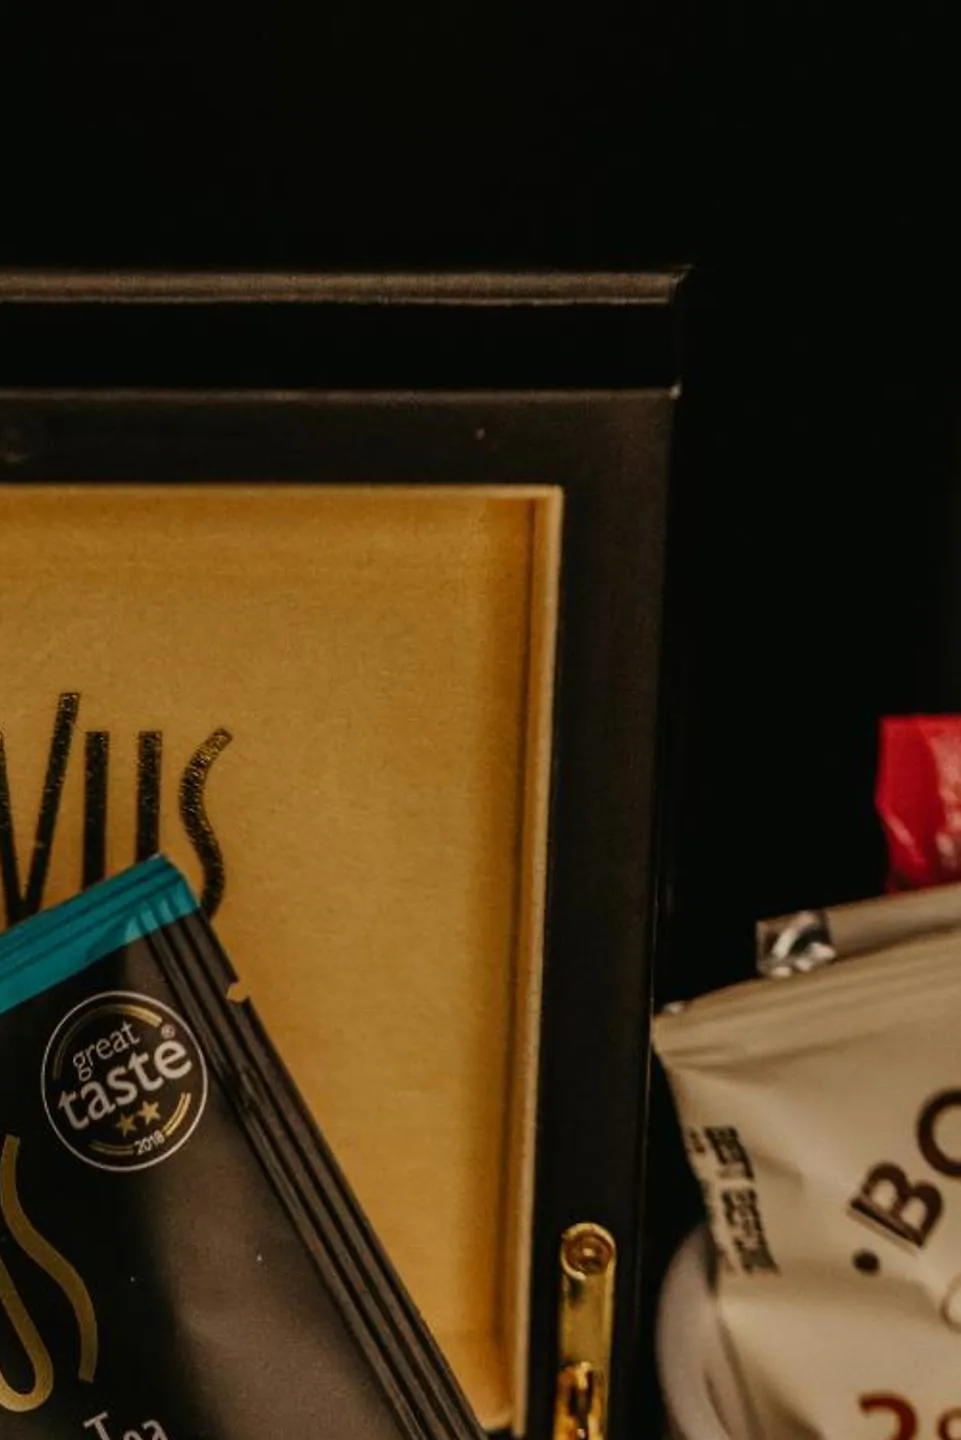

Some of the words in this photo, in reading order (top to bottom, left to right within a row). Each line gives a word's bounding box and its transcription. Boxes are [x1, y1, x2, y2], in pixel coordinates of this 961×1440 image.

[72, 1019, 140, 1082] great
[57, 1040, 193, 1130] taste
[133, 1129, 166, 1155] 2018
